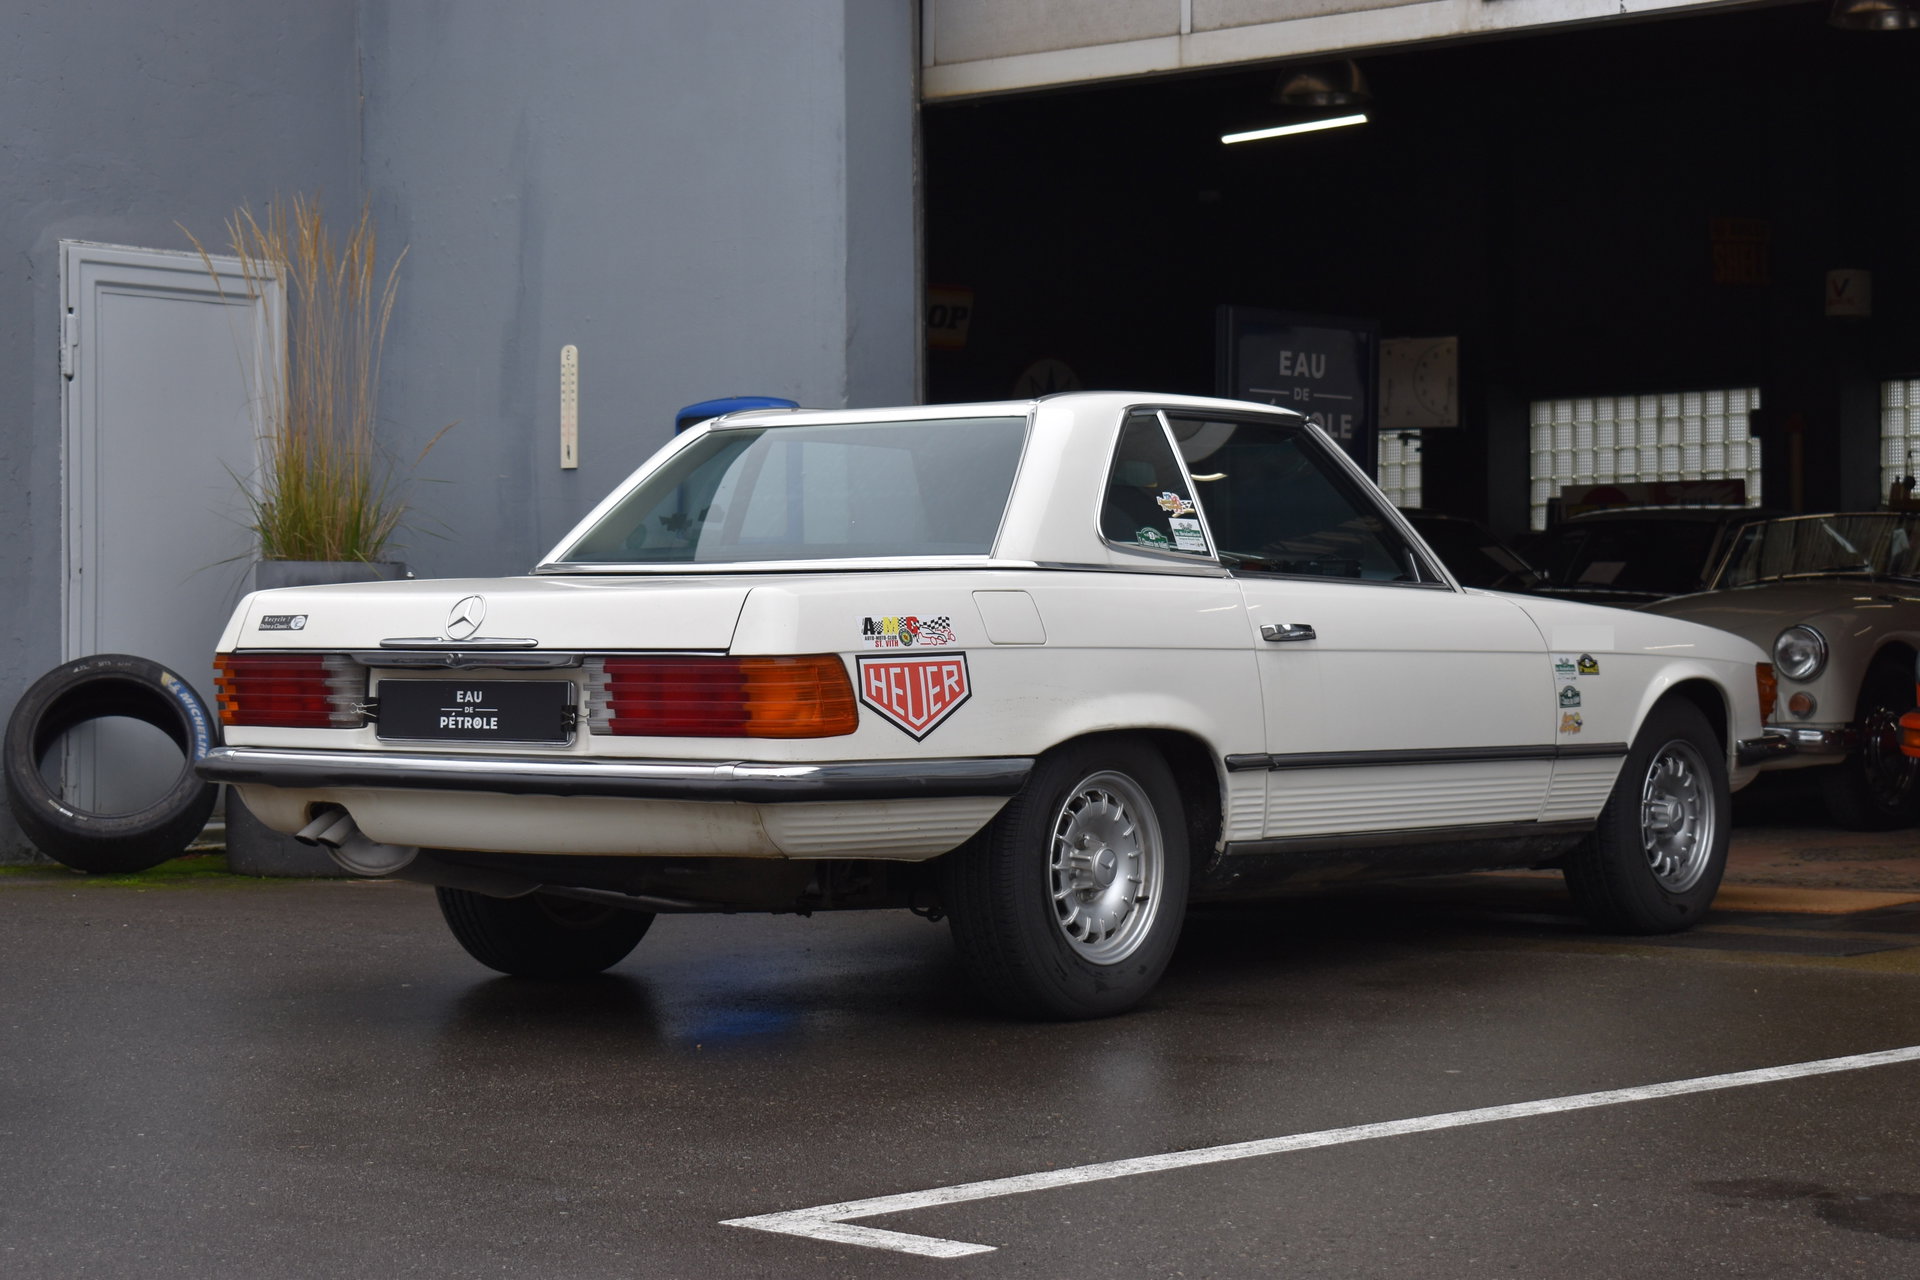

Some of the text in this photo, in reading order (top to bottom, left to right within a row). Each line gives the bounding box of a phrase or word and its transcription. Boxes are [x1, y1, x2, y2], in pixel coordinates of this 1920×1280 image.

[1279, 350, 1326, 379] EAU
[1293, 387, 1310, 402] DE
[456, 690, 483, 703] EAU
[869, 665, 960, 727] HEUER
[180, 692, 208, 759] MICHELIN
[440, 711, 498, 729] PÉTROLE
